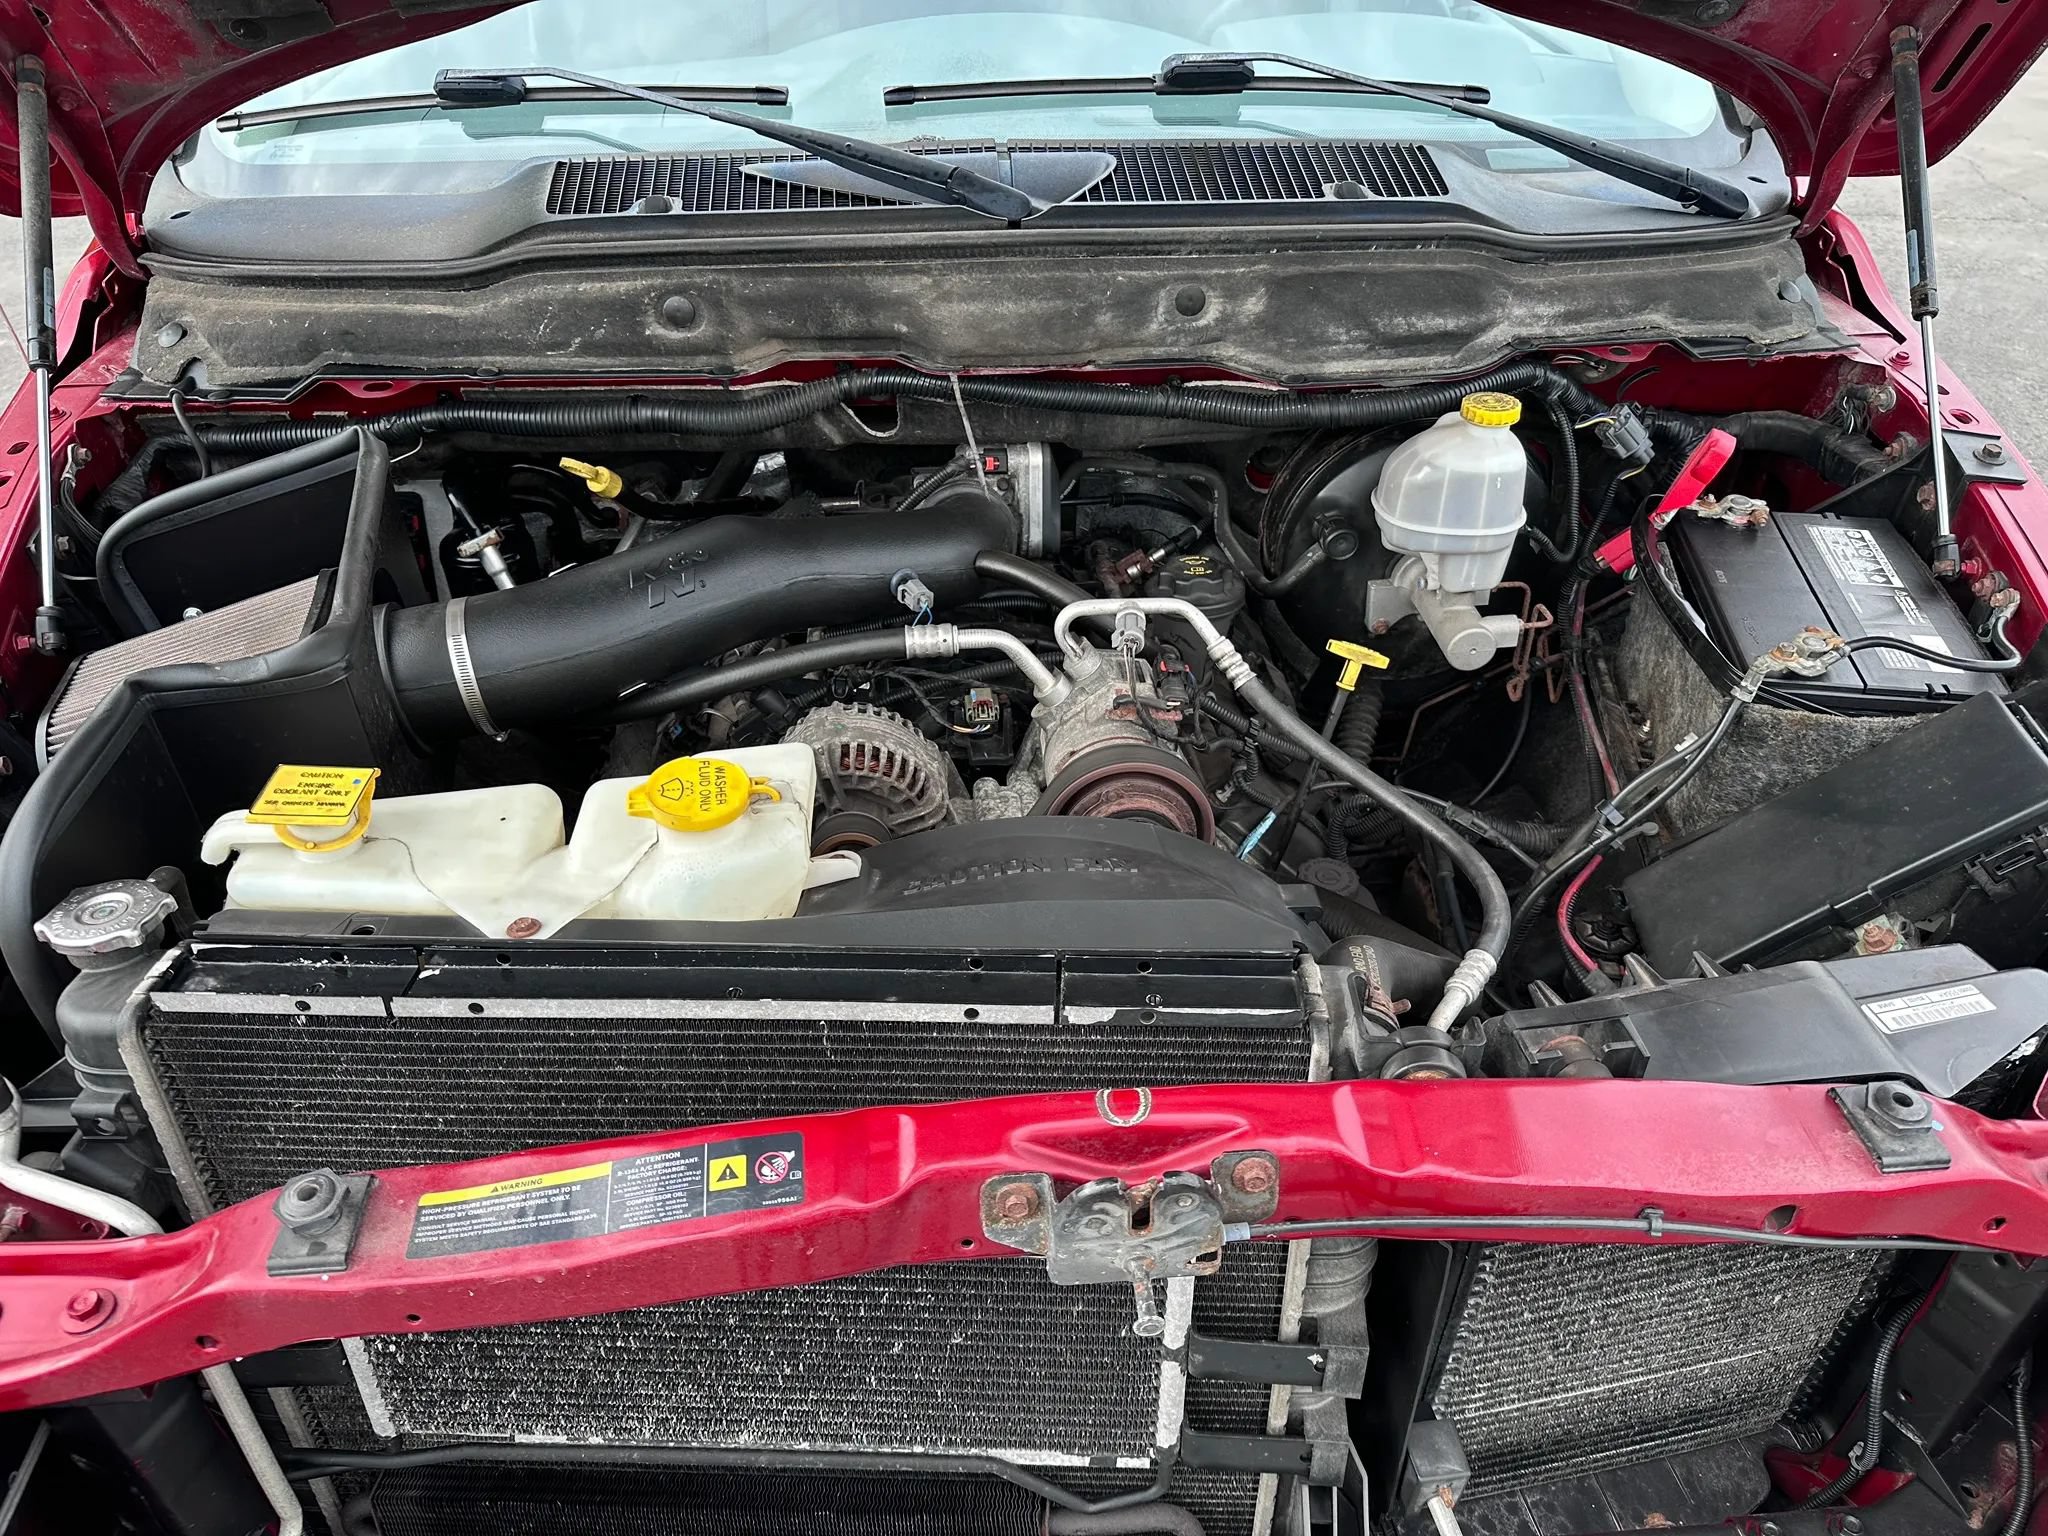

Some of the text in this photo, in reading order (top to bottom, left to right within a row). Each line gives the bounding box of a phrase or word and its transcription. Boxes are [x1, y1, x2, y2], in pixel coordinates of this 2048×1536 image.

[699, 761, 711, 812] FLUID ONLY
[714, 766, 727, 805] WASHER
[273, 788, 321, 796] COOLANT
[636, 1152, 680, 1164] ATTENTION
[654, 1157, 698, 1169] REFRIGERANT
[628, 1170, 656, 1180] FACTORY
[501, 1178, 543, 1192] WARNING
[422, 1202, 481, 1215] HIGH-PRESSURE
[482, 1194, 530, 1206] REFRIGERANT
[532, 1190, 559, 1198] SYSTEM
[626, 1194, 671, 1206] COMPRESSOR
[420, 1212, 456, 1222] SERVICED
[468, 1205, 505, 1215] QUALIFIED
[507, 1198, 549, 1209] PERSONNEL
[551, 1195, 571, 1203] ONLY.
[538, 1212, 568, 1220] PERSONAL
[483, 1224, 529, 1234] REQUIREMENTS
